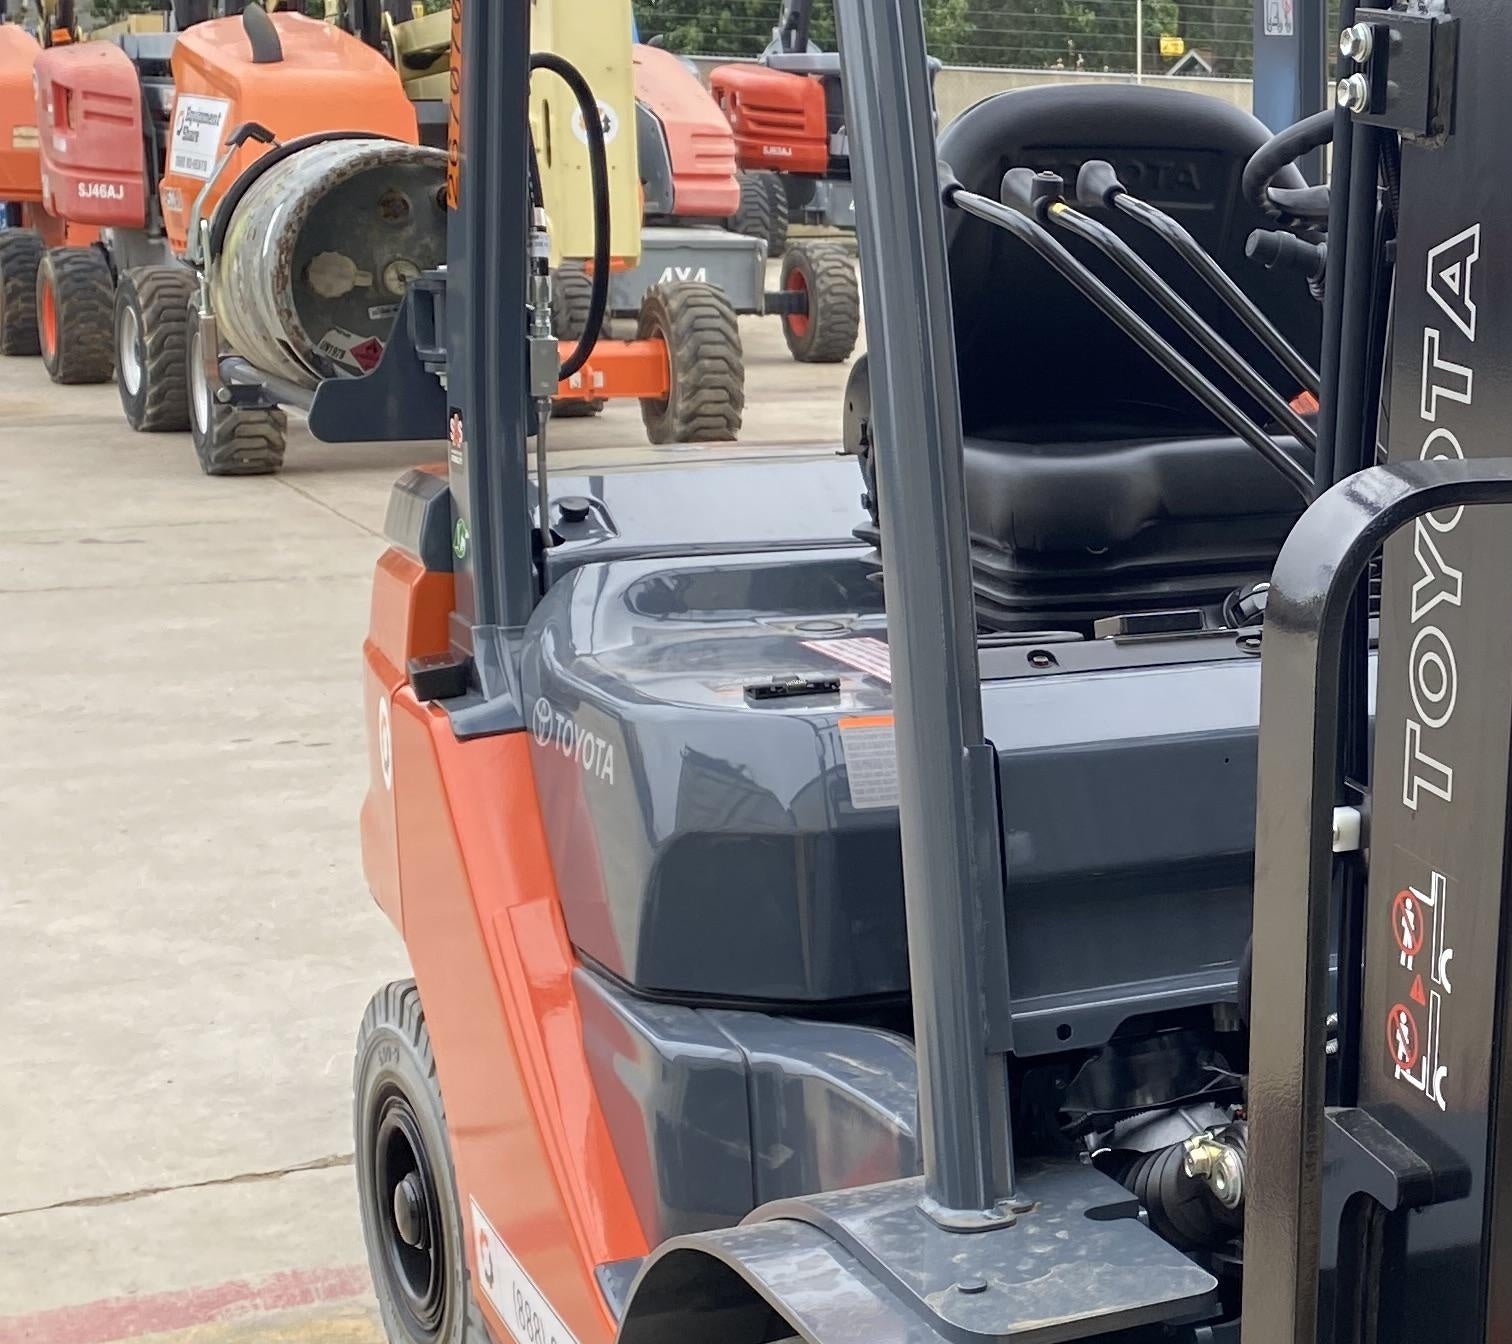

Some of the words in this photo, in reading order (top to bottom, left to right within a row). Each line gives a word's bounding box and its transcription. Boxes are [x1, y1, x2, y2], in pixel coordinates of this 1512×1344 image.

[78, 182, 124, 199] SJ46AJ
[1402, 221, 1482, 810] TOYOTA
[555, 712, 614, 785] TOYOTA
